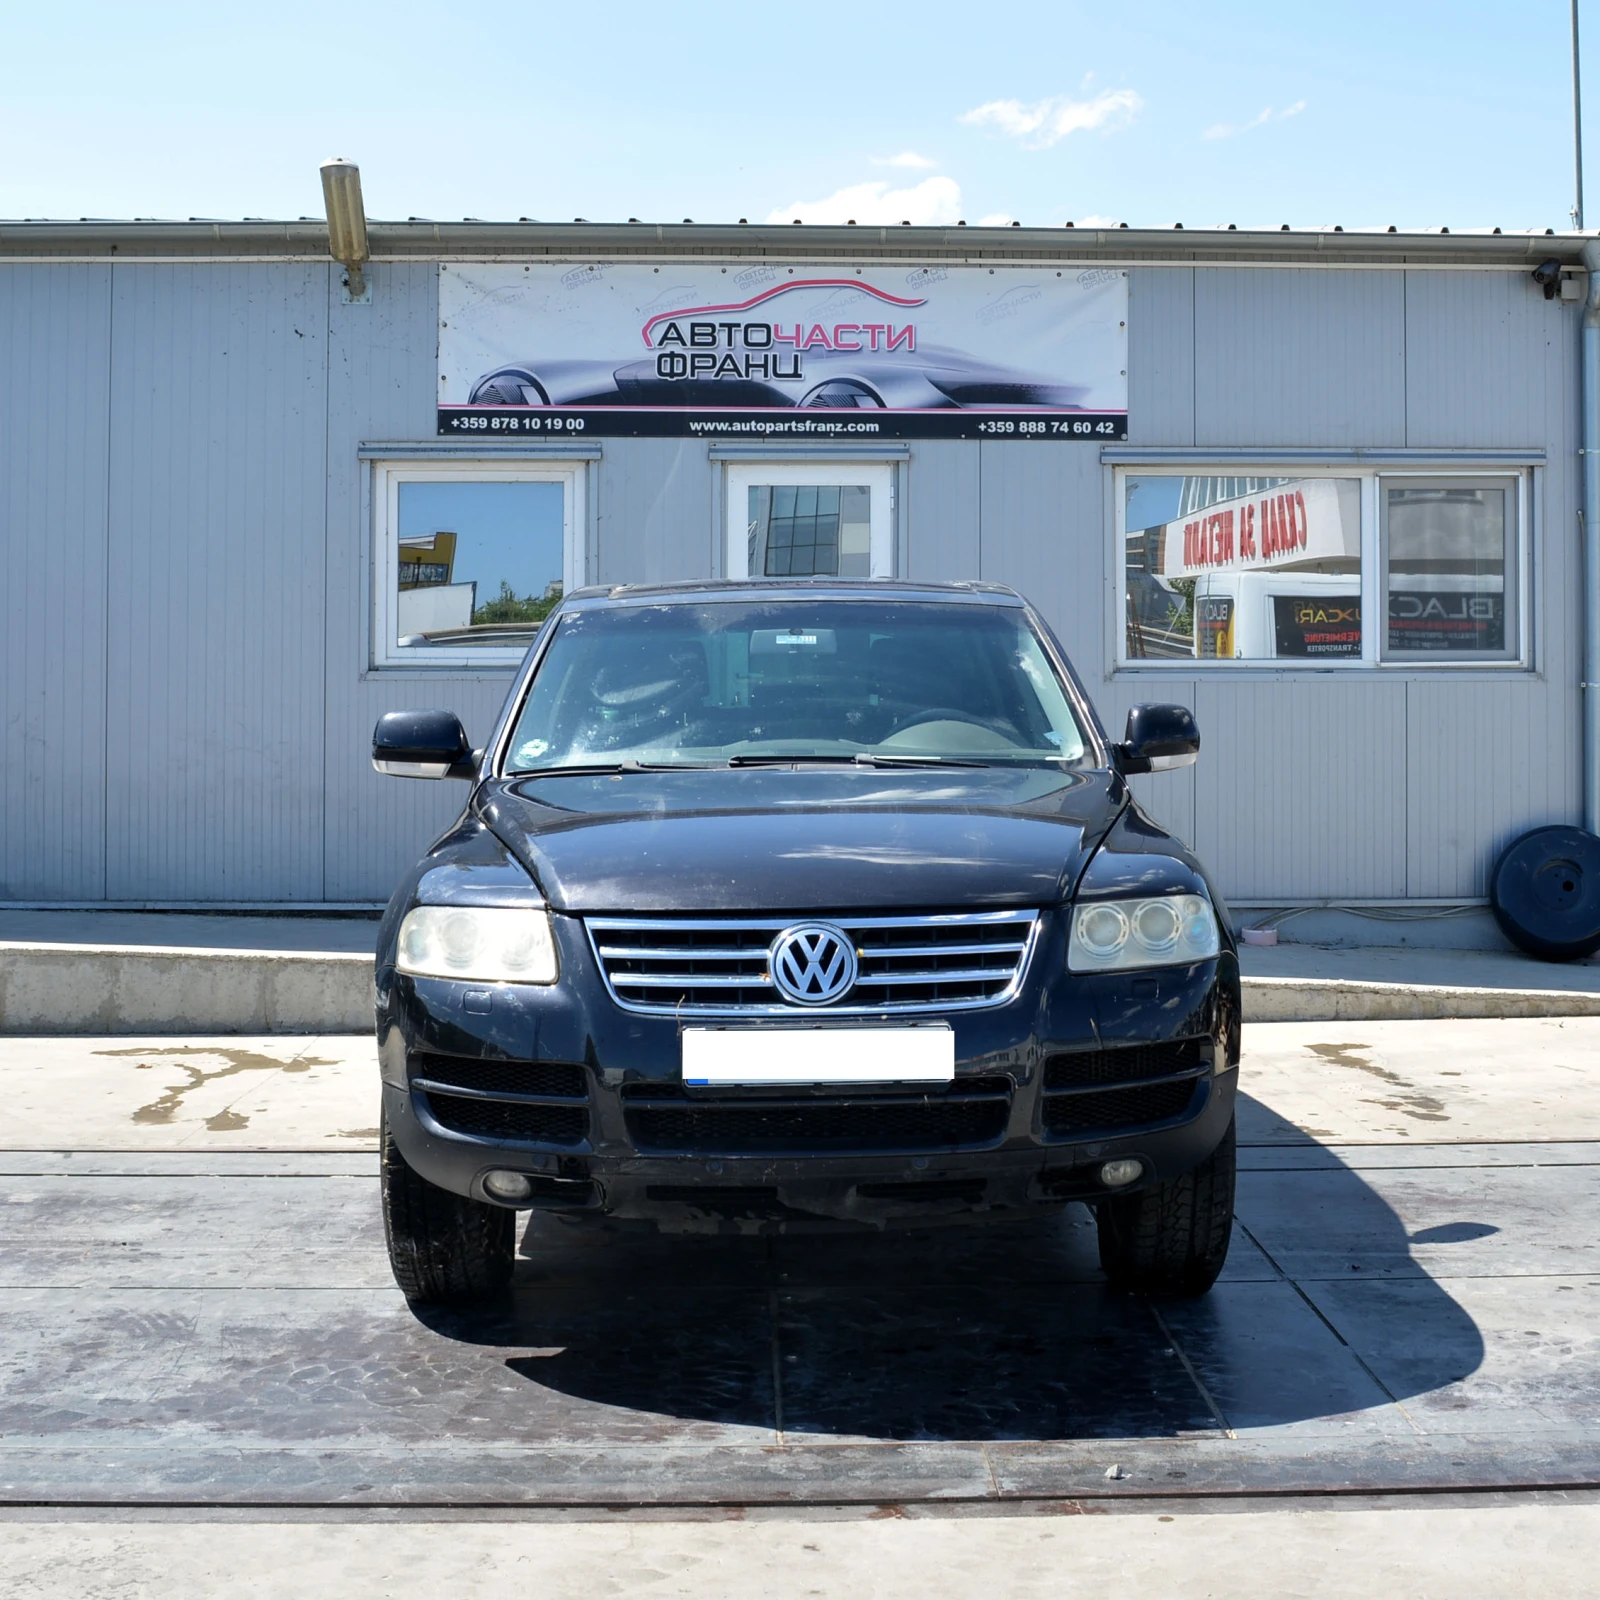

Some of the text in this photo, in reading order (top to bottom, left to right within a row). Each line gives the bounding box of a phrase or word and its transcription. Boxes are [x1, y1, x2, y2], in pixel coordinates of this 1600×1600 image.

[657, 323, 915, 350] АВТОЧАСТИ
[657, 351, 803, 381] ФРАНЦ
[451, 417, 585, 430] +359 878 10 19 00
[689, 420, 880, 434] www.autopartsfranz.com
[978, 420, 1114, 433] +359 888 74 60 42
